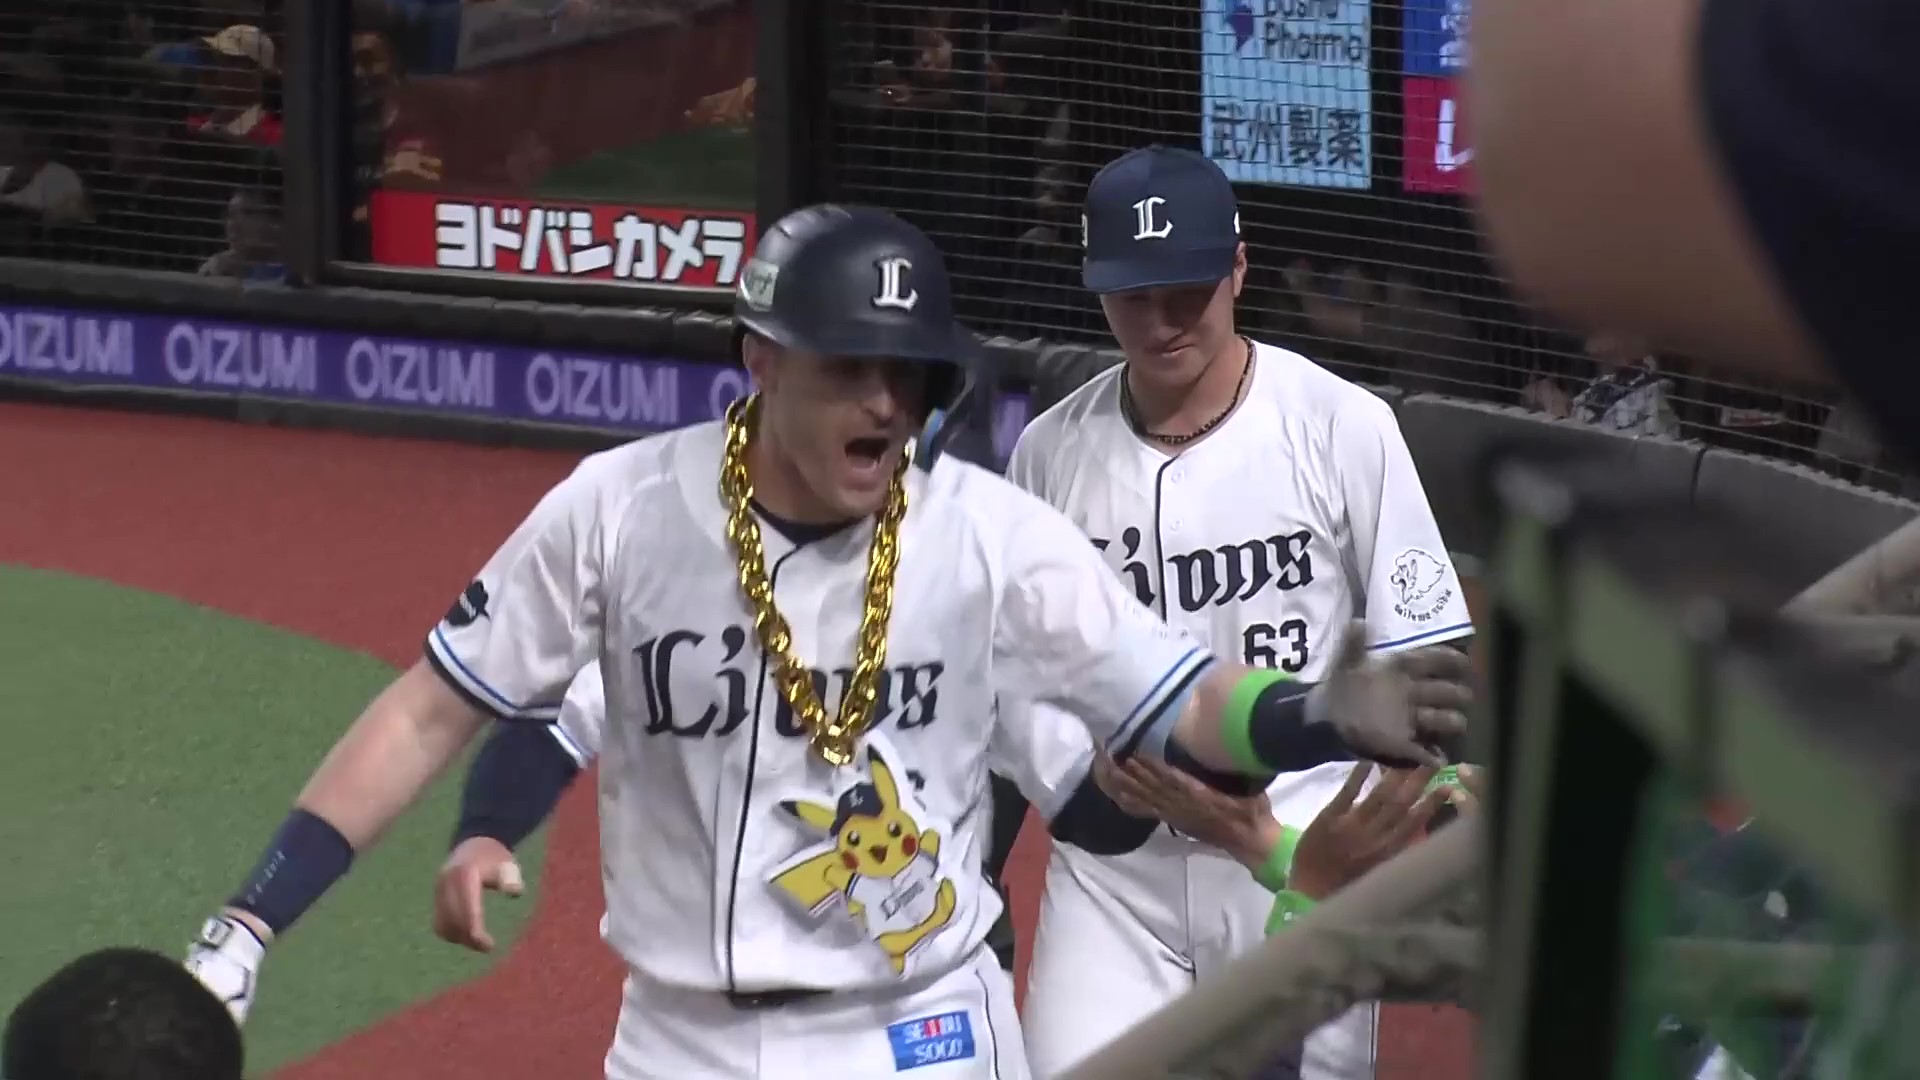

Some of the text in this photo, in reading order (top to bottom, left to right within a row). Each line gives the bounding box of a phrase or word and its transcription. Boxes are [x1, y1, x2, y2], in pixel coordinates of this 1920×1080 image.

[1265, 20, 1362, 60] Pharma
[1211, 100, 1362, 168] 武州製薬
[435, 202, 746, 285] ヨドバシカメラ
[1131, 196, 1173, 241] L
[873, 256, 918, 312] L
[164, 322, 317, 391] OIZUMI
[345, 337, 495, 407] OIZUMI
[526, 353, 679, 424] OIZUMI
[1090, 526, 1314, 612] ions
[1242, 619, 1308, 672] 63
